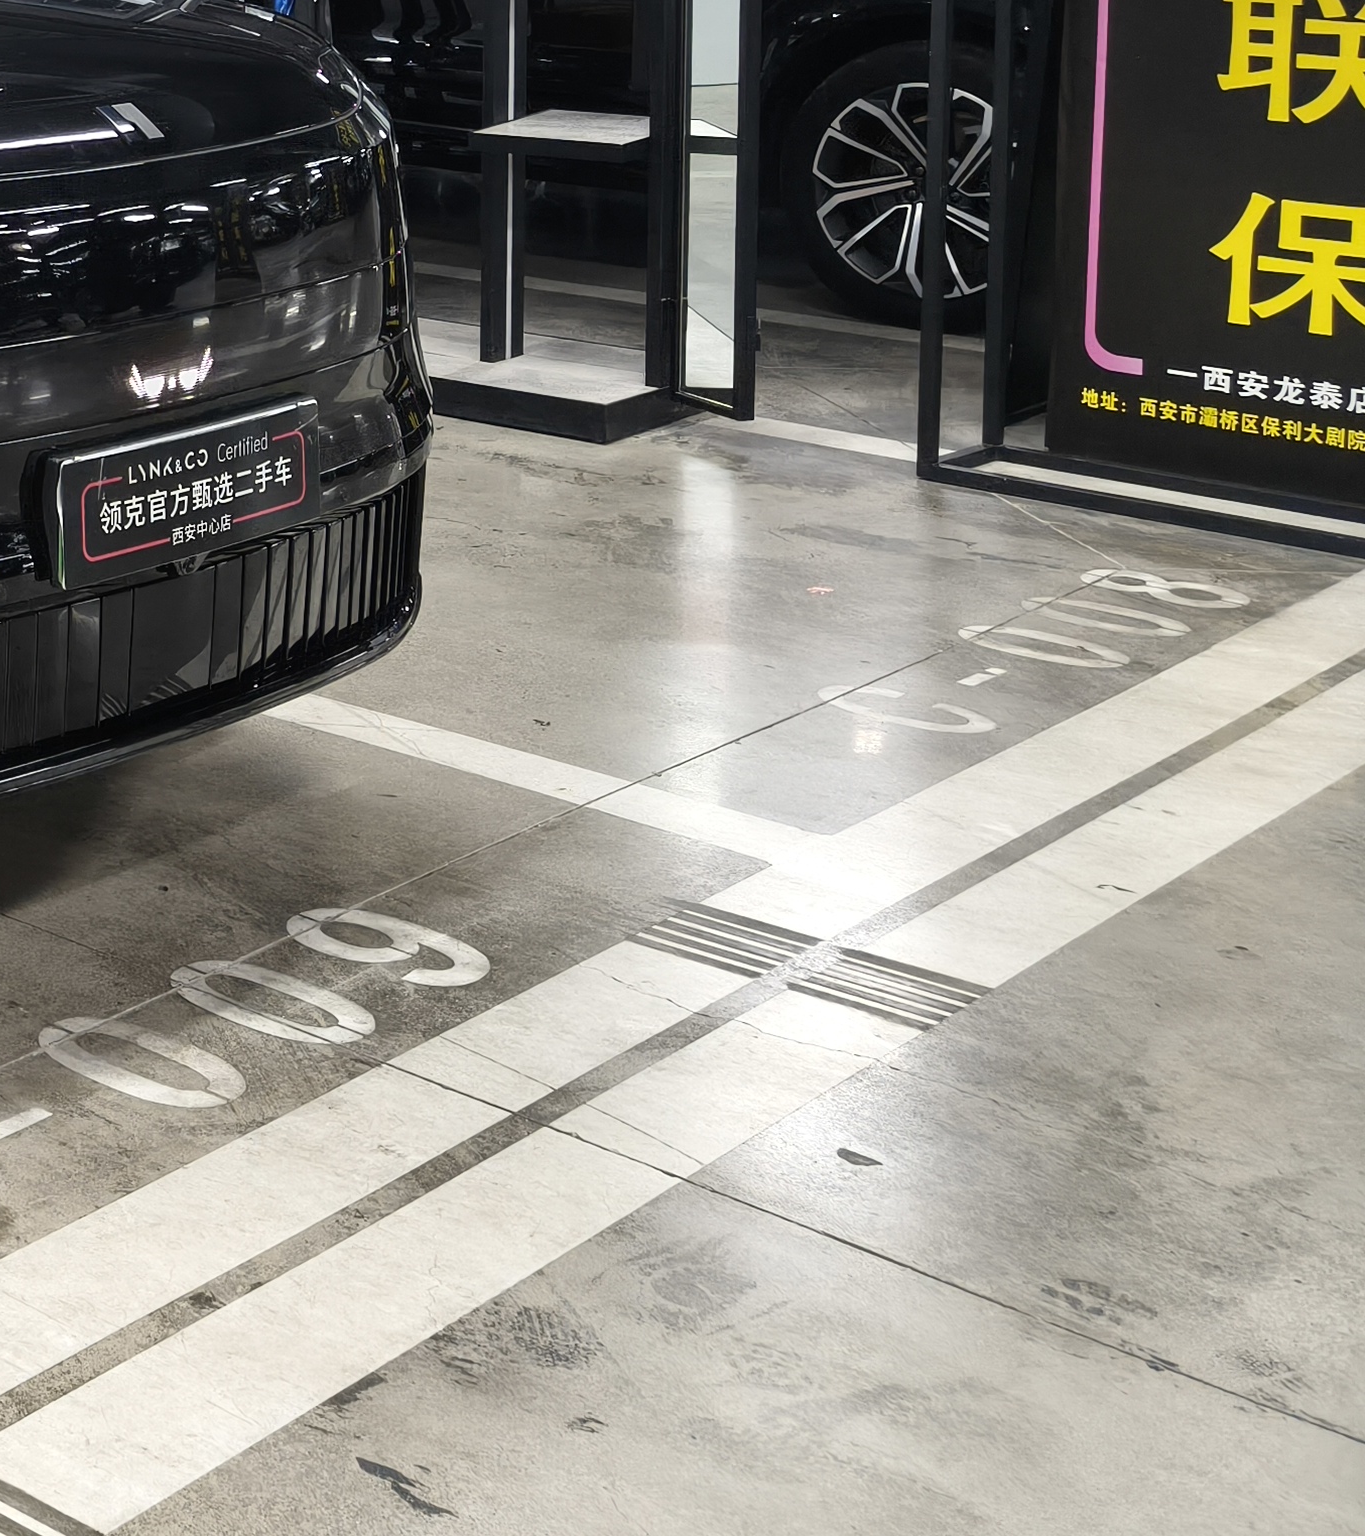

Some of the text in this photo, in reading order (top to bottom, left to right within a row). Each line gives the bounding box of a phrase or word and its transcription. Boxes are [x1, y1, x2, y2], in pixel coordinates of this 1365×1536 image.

[127, 430, 269, 485] LYNK&CO Certified
[99, 456, 293, 535] 领克官方甄选二手车
[171, 514, 232, 547] 西安中心店
[816, 568, 1252, 734] C-008
